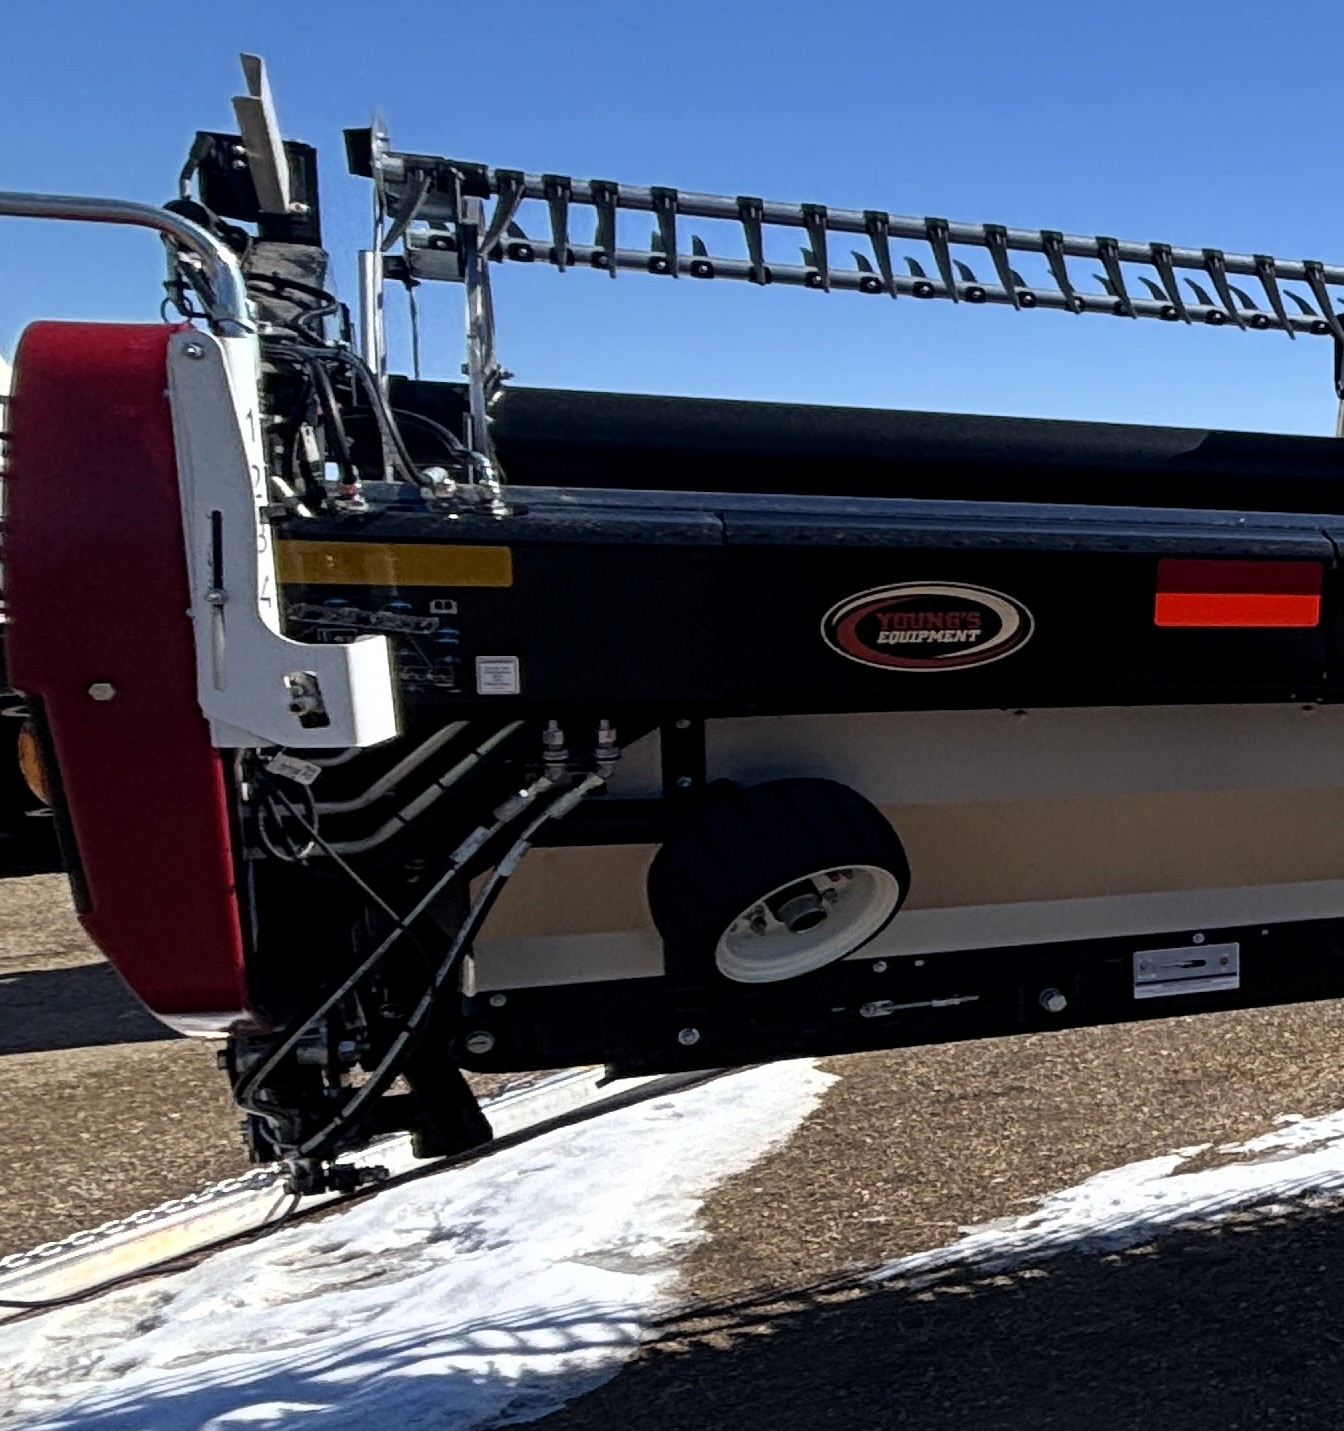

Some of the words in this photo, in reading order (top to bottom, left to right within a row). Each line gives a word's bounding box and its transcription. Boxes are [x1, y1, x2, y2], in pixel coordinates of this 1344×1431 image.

[246, 407, 256, 442] 1
[876, 612, 981, 629] YOUNG'S
[877, 630, 981, 644] EQUIPMENT
